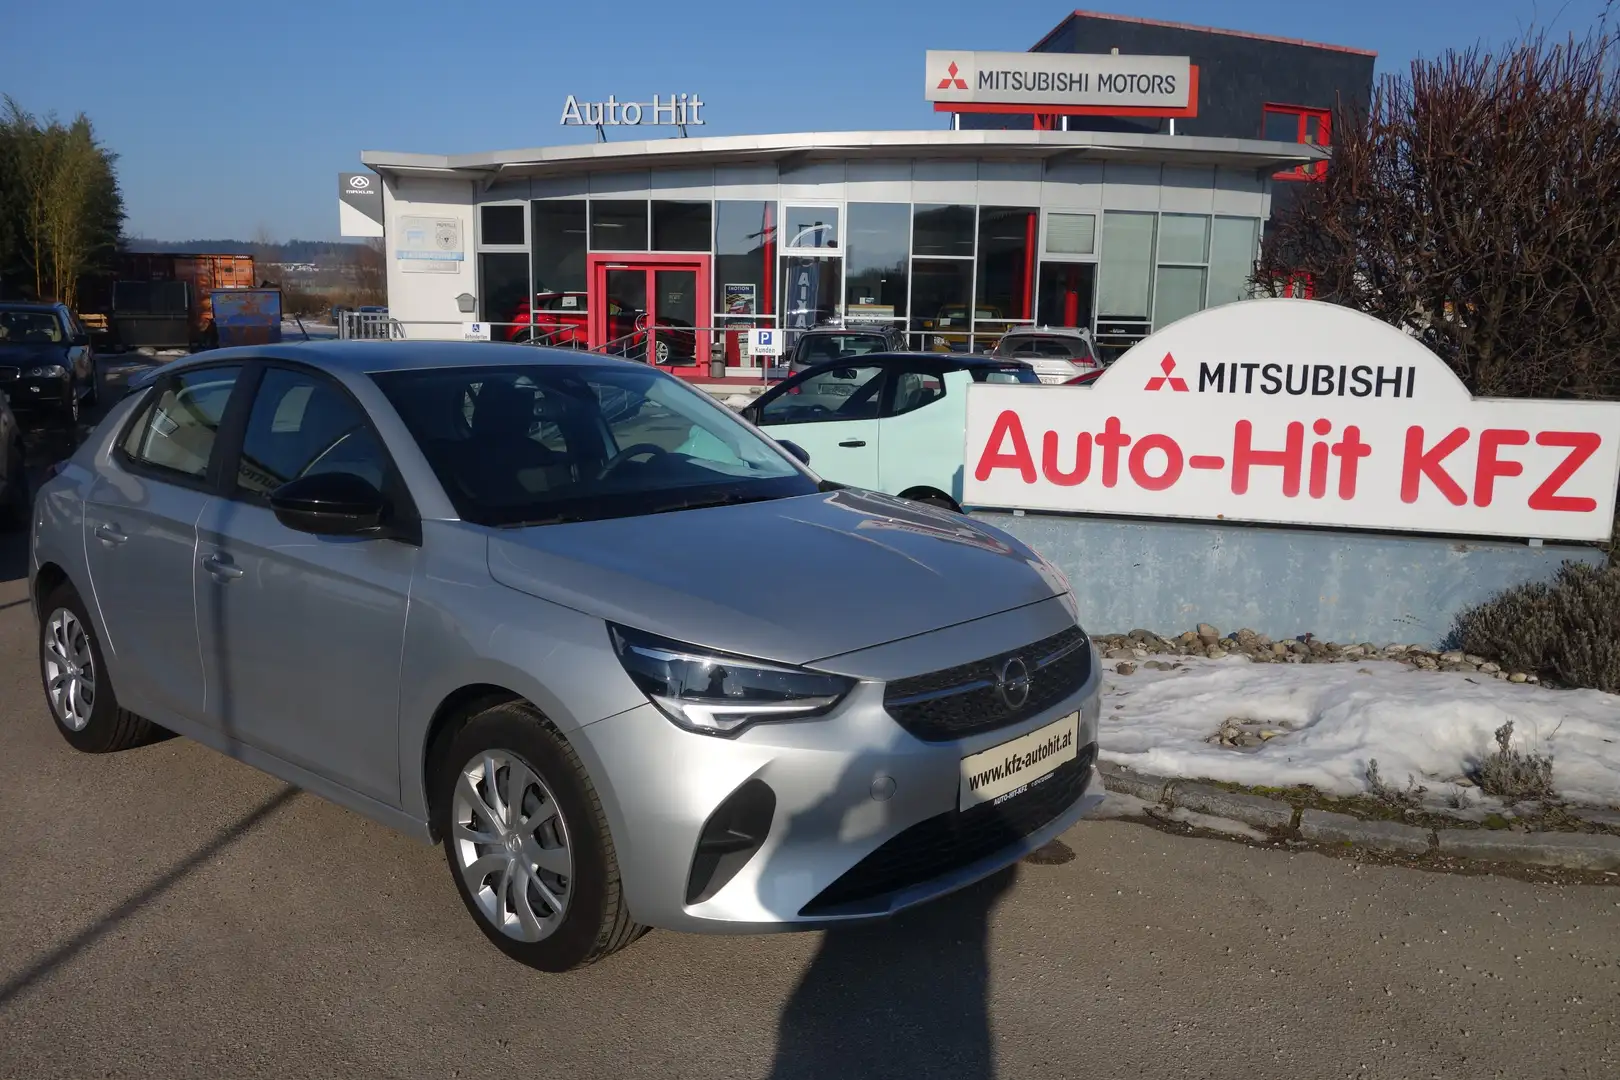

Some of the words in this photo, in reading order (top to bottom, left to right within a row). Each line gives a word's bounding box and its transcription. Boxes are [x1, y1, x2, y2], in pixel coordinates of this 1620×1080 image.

[978, 70, 1089, 92] MITSUBISHI
[1097, 73, 1176, 95] MOTORS
[560, 94, 642, 125] Auto
[653, 93, 704, 125] Hit
[761, 332, 769, 344] P
[1198, 362, 1416, 398] MITSUBISHI
[975, 409, 1372, 500] Auto-Hit
[1401, 425, 1602, 512] KFZ
[969, 727, 1073, 792] www.kfz-autohit.at
[993, 784, 1029, 806] AUTO-HIT-KFZ
